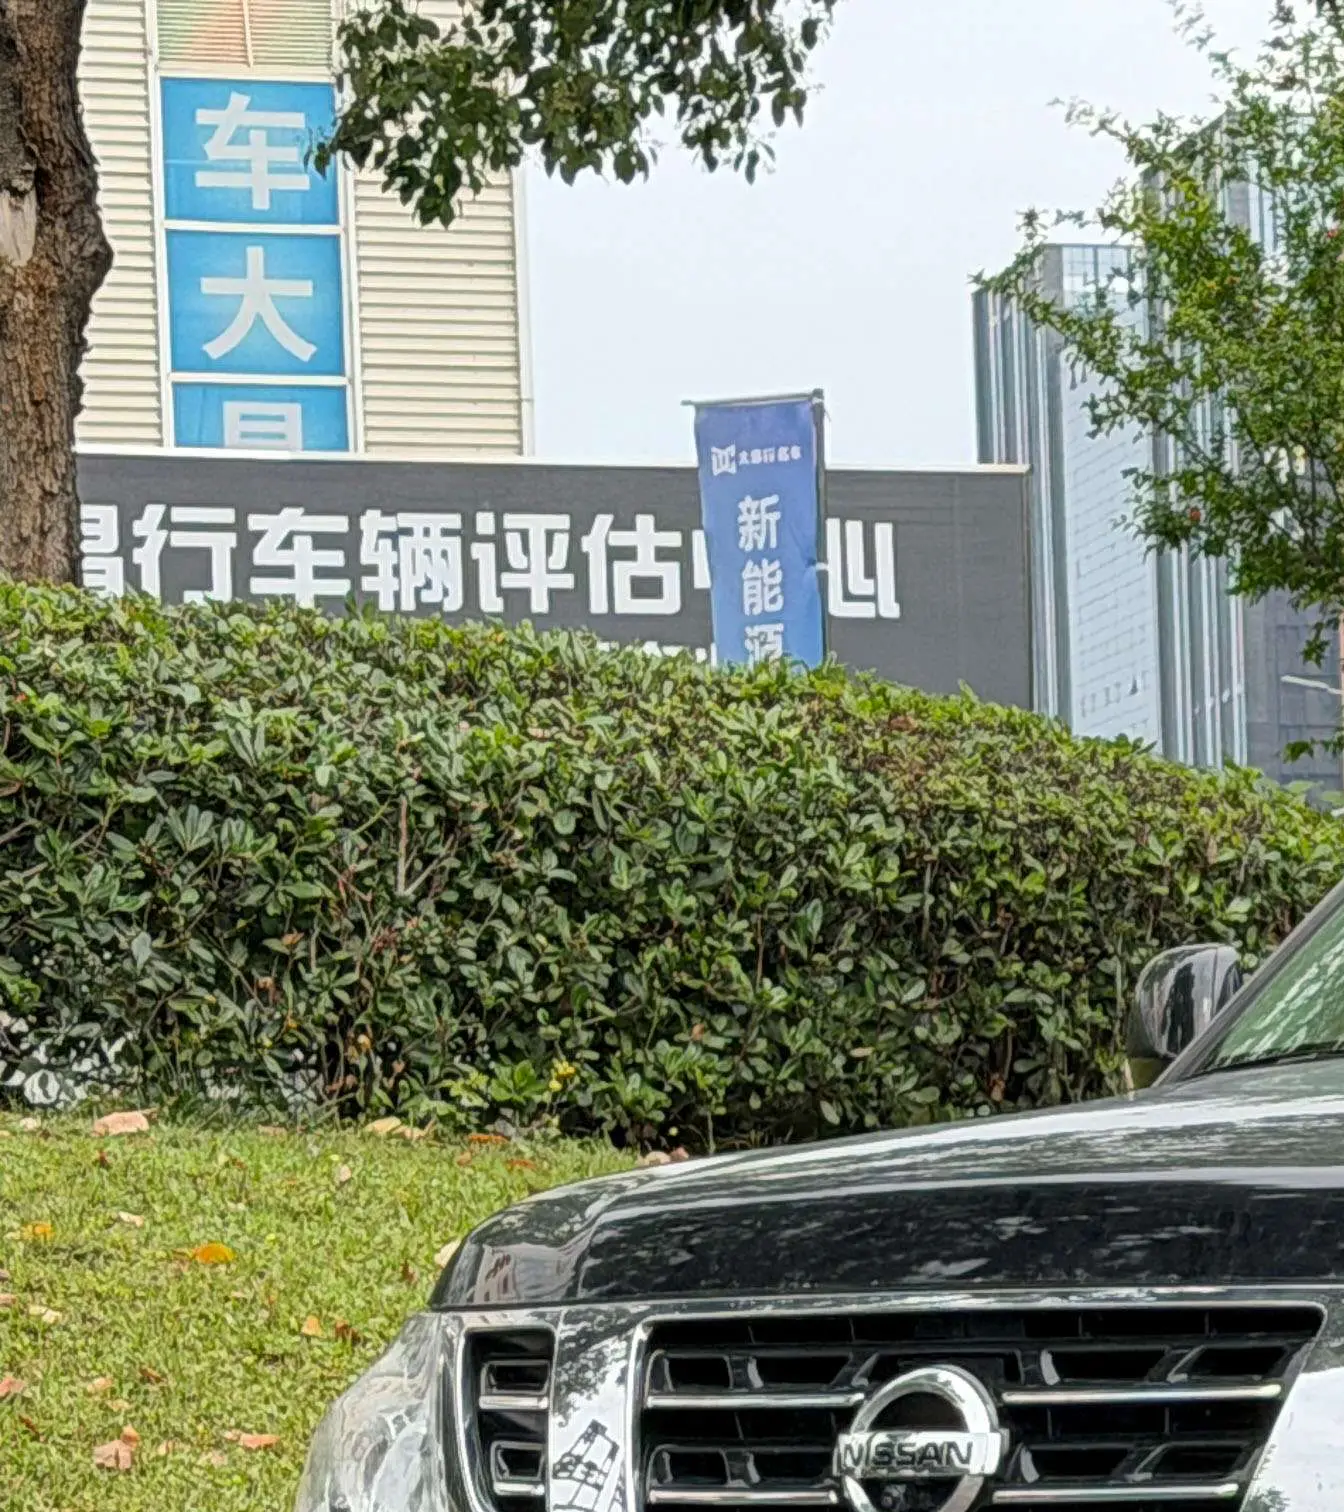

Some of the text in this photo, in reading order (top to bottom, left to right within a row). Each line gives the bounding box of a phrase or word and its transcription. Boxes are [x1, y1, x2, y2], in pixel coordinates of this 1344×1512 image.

[80, 503, 901, 619] 行车辆评估心
[842, 1440, 974, 1467] NISSAN
